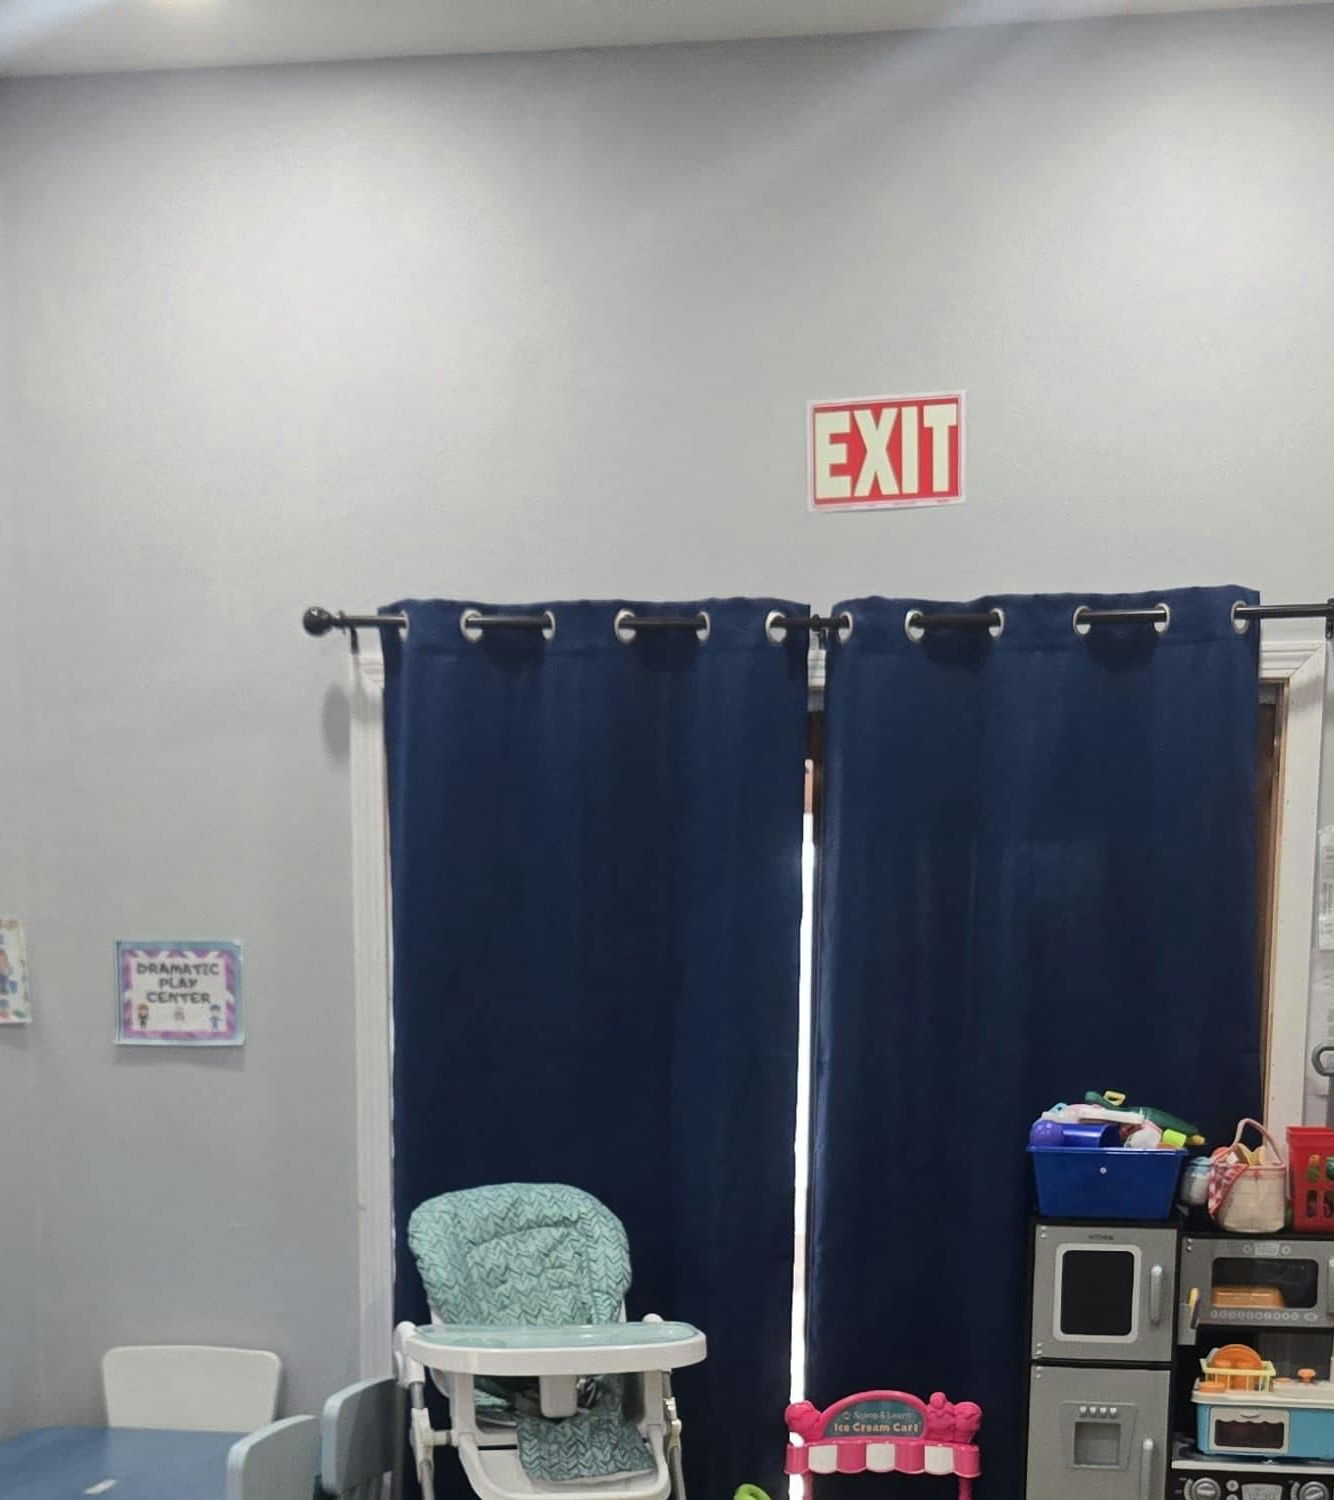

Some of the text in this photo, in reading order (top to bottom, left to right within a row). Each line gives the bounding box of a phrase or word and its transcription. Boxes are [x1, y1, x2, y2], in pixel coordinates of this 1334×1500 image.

[815, 403, 958, 499] EXIT
[136, 962, 219, 976] DRAMATIC
[158, 977, 198, 990] PLAY
[145, 991, 211, 1005] CENTER
[834, 1422, 919, 1433] Ice Cream Cart
